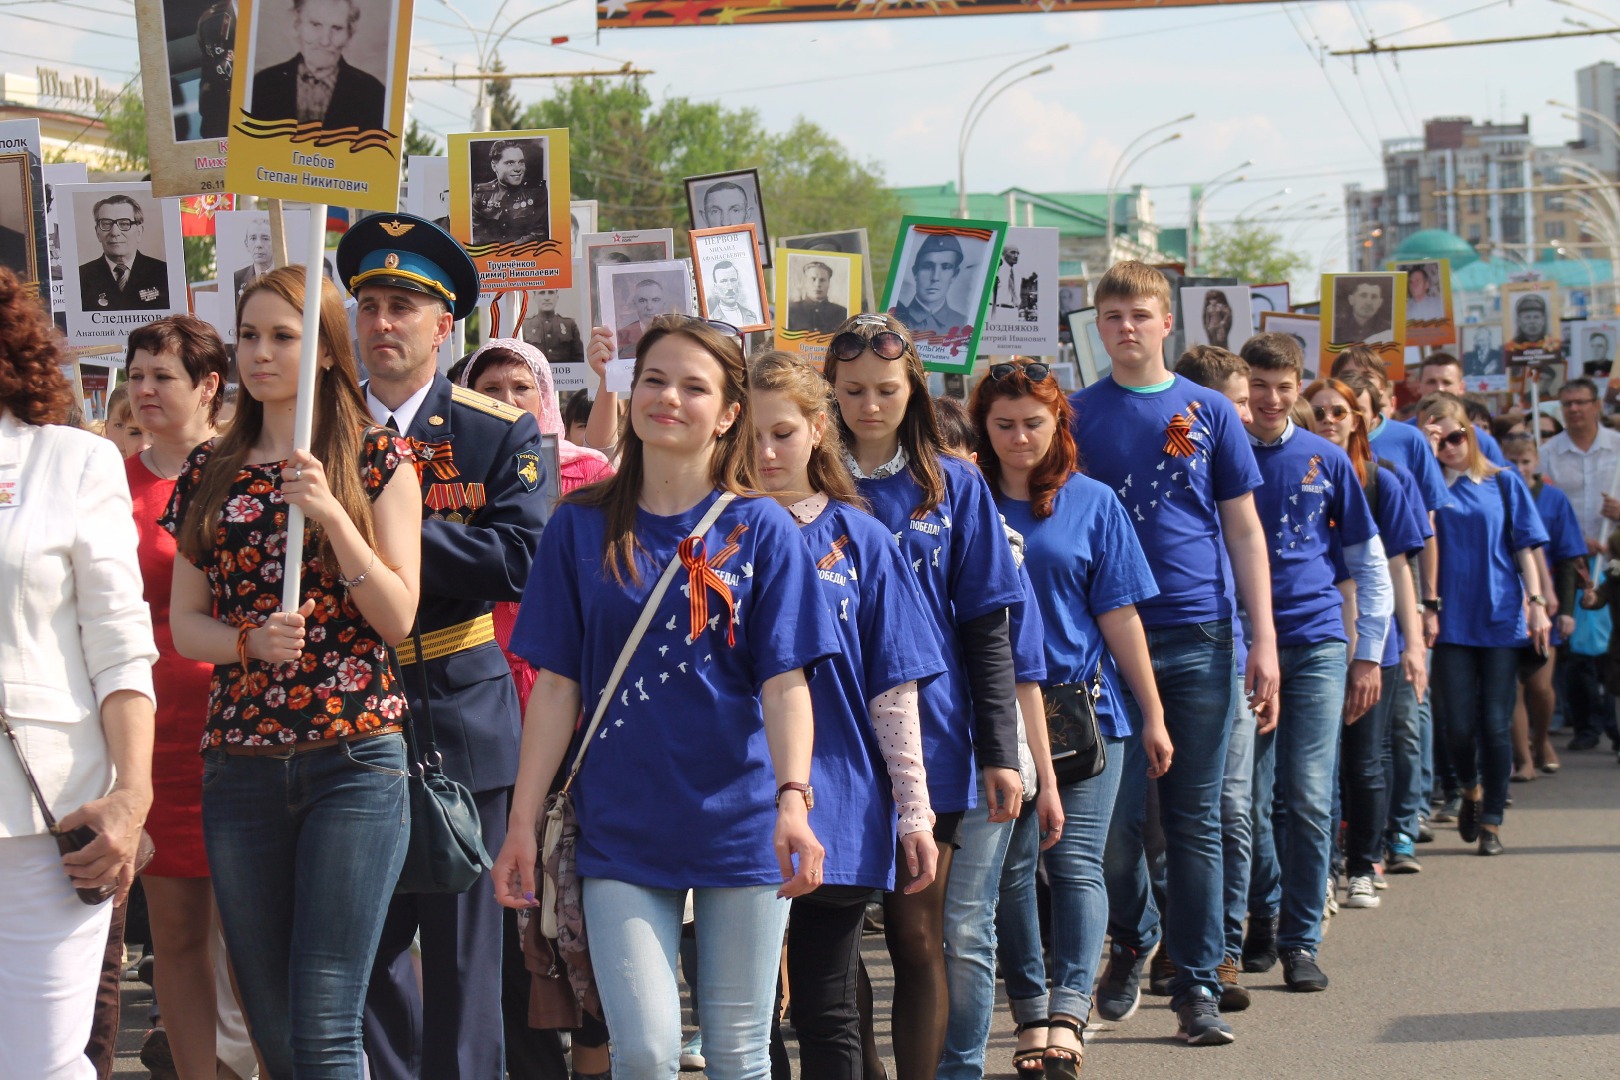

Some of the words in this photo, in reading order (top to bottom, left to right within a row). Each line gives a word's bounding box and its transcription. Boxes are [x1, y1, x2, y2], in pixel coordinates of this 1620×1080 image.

[292, 151, 336, 169] Глебов
[256, 166, 298, 185] Степан
[302, 172, 369, 193] Никитович
[704, 233, 739, 246] ПЕРВОВ
[702, 251, 746, 262] АФАНАСЬЕВИЧ
[487, 259, 536, 272] Трунчёнков
[508, 264, 560, 278] Николаевич
[91, 312, 162, 325] Следников
[75, 329, 115, 338] Анатолий
[910, 519, 940, 536] ПОБЕДА!
